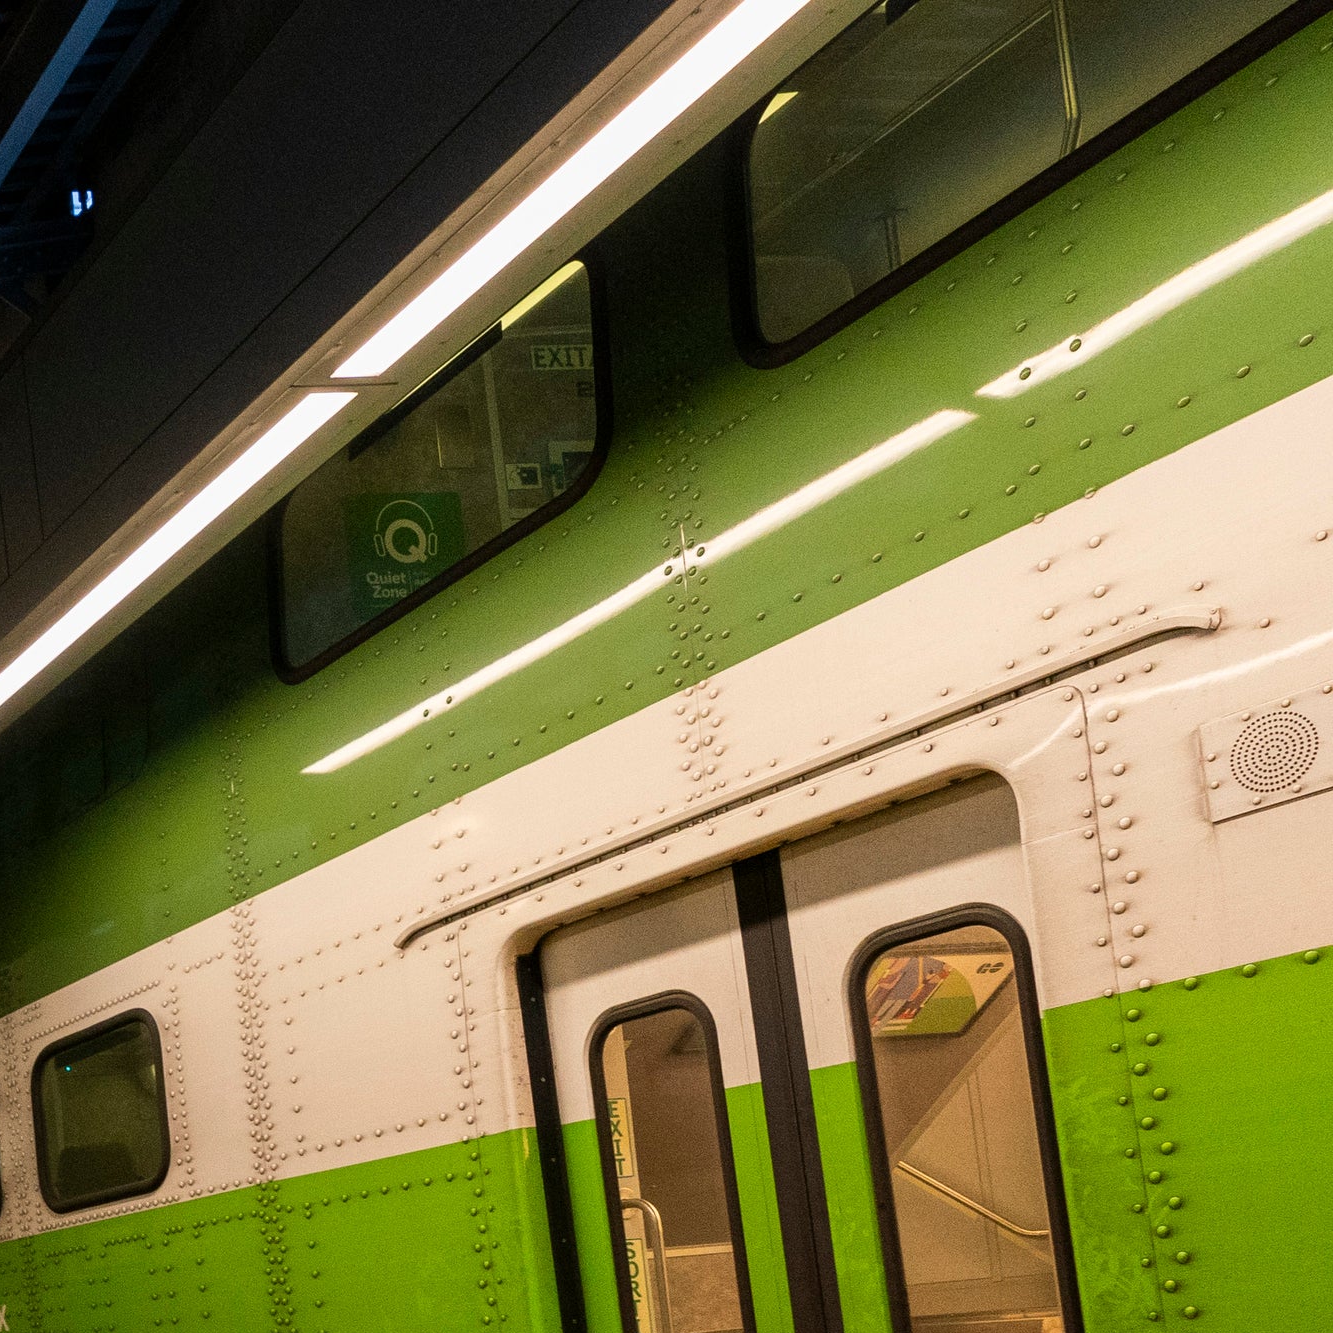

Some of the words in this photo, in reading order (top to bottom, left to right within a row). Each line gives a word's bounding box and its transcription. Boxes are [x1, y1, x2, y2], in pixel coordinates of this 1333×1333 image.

[366, 571, 407, 585] Quiet
[372, 585, 408, 598] Zone
[608, 1100, 626, 1176] EXIT
